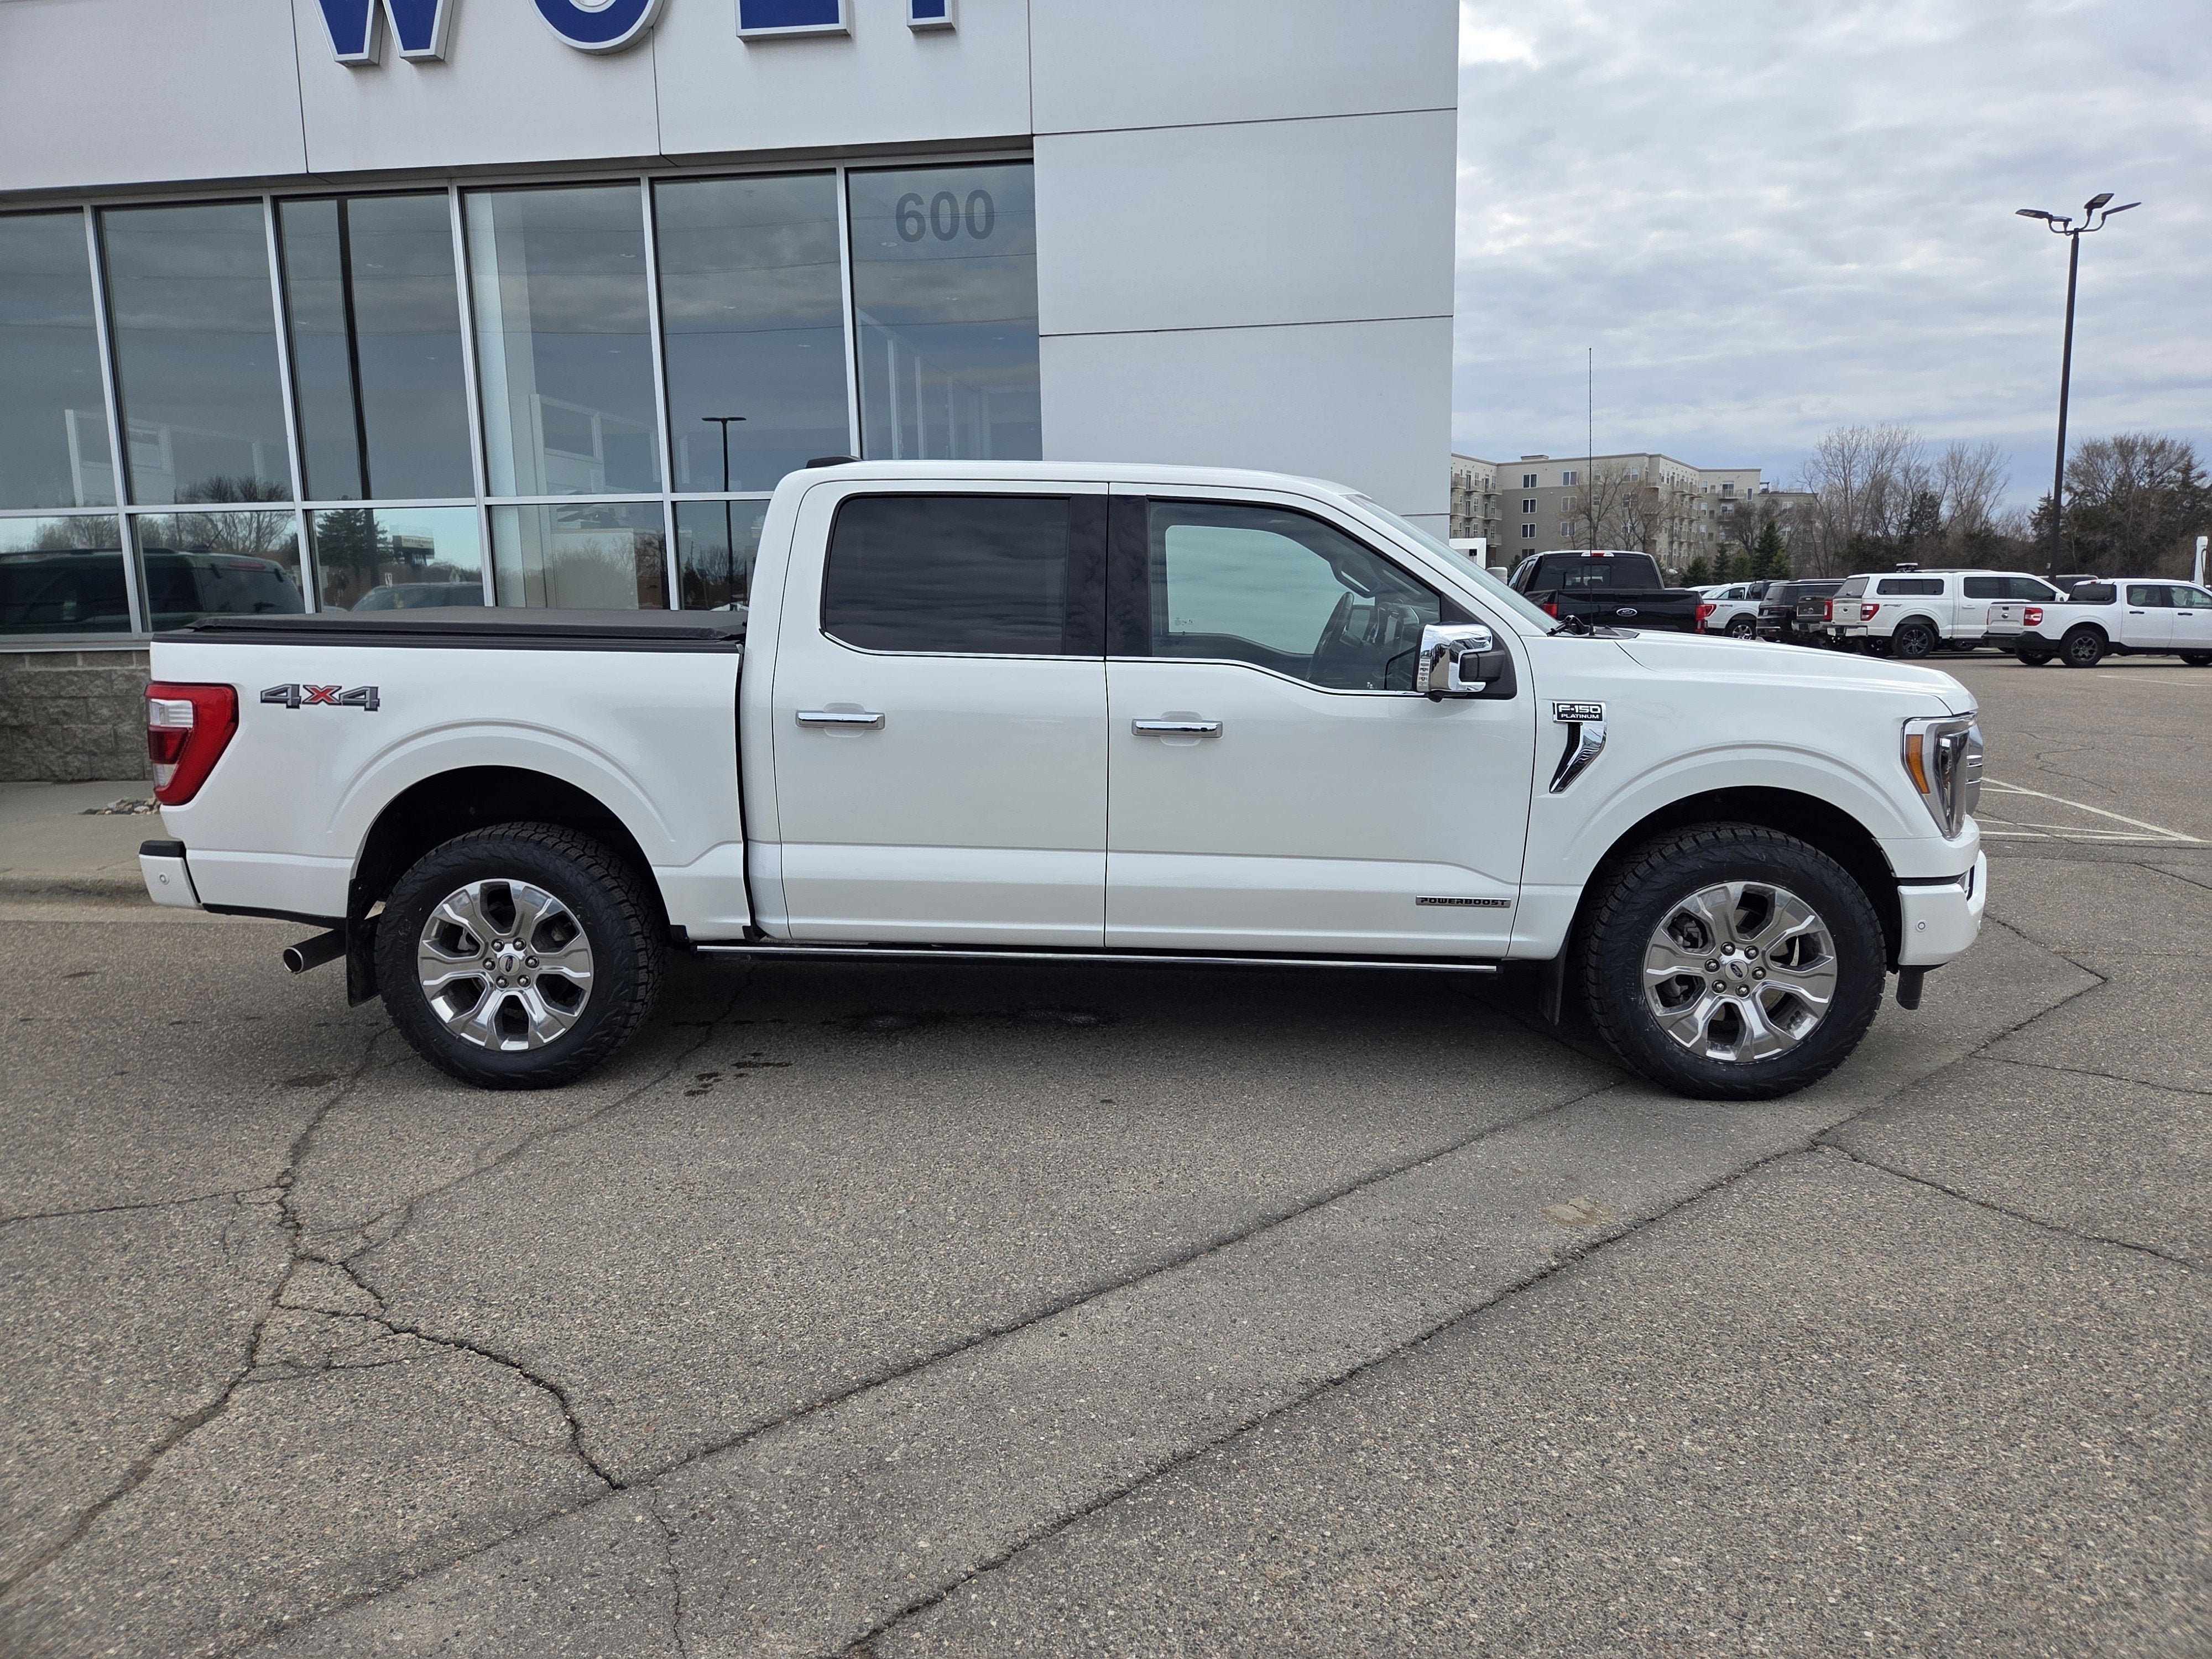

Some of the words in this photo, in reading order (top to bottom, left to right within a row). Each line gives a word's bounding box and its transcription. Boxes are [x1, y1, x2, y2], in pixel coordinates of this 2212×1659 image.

[896, 190, 995, 242] 600
[1558, 705, 1601, 713] F-150
[1421, 897, 1507, 906] POWERBOOST
